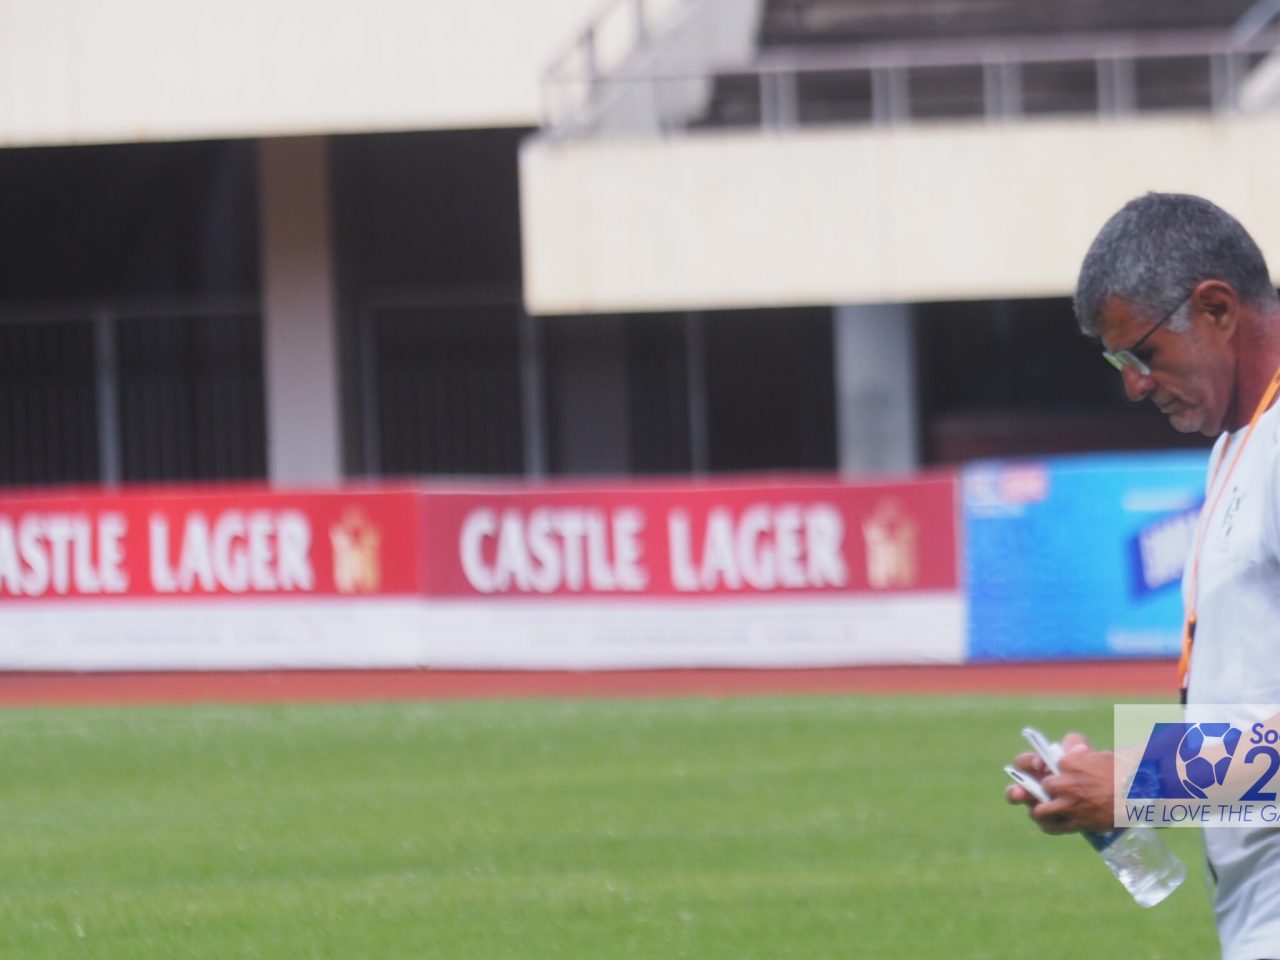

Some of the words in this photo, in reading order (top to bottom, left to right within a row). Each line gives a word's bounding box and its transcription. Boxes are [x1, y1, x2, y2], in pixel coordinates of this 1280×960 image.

[148, 508, 314, 593] LAGER
[460, 505, 647, 593] CASTLE
[668, 502, 848, 592] LAGER
